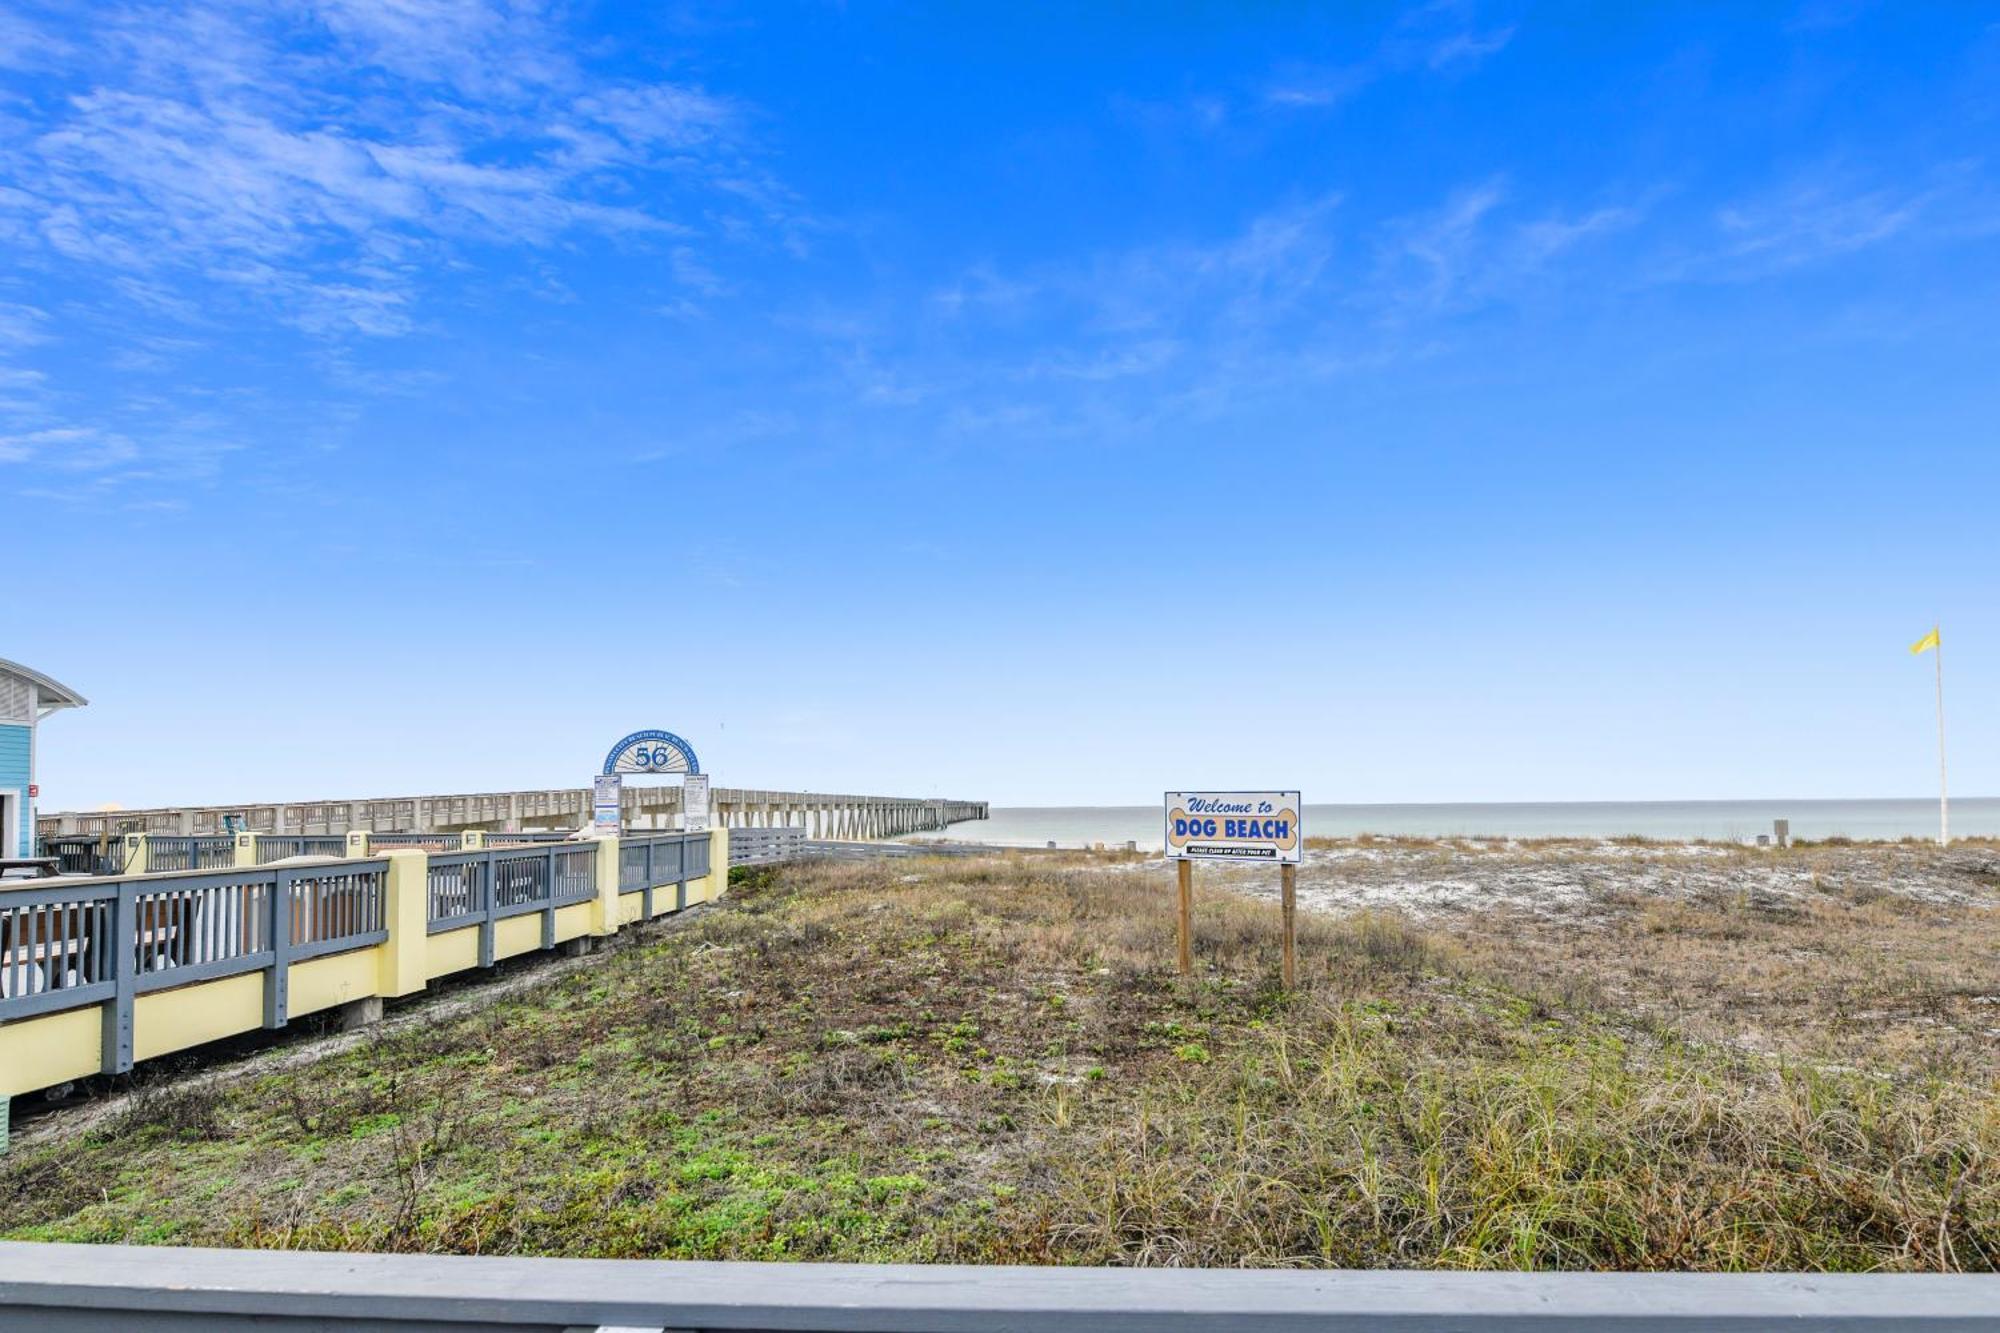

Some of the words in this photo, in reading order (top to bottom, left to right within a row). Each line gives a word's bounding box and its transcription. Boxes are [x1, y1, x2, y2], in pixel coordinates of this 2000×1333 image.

[636, 747, 668, 766] 56
[1187, 797, 1252, 813] Welcome
[1258, 800, 1273, 814] to
[1175, 818, 1217, 837] DOG
[1225, 819, 1289, 839] BEACH
